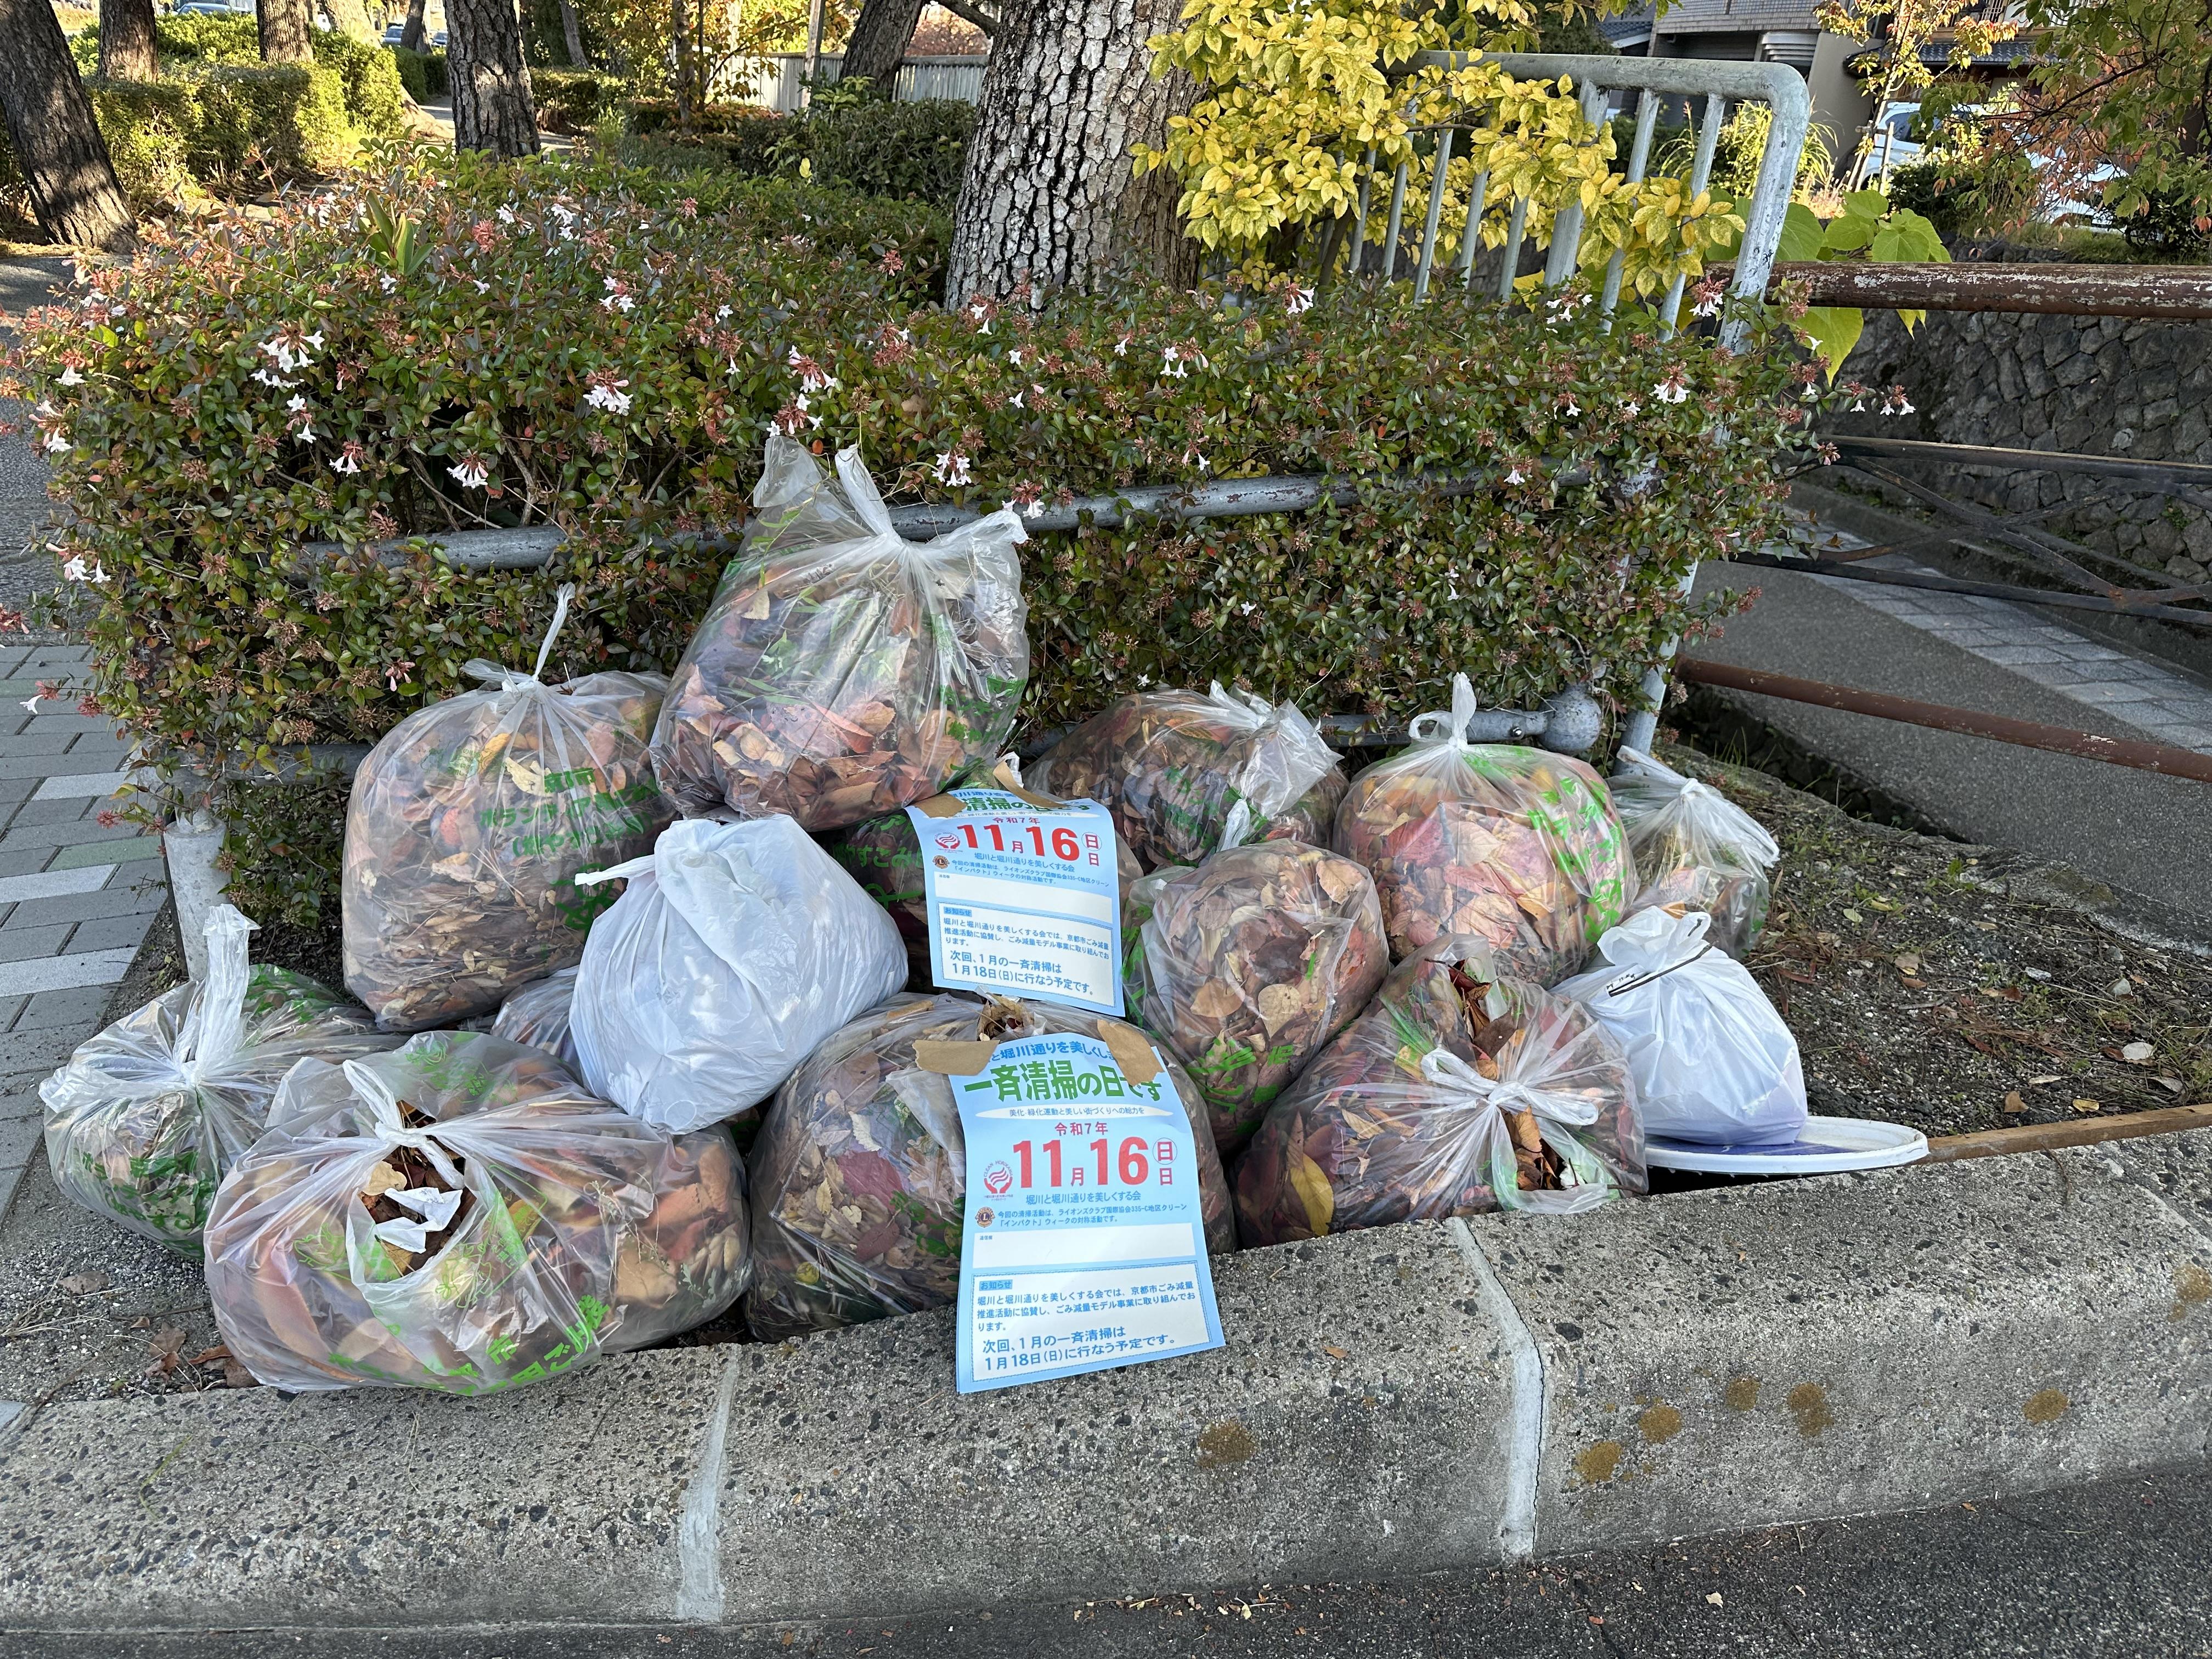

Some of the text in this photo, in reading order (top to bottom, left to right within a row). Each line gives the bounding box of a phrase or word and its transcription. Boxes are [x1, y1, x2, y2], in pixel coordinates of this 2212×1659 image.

[974, 852, 1075, 872] 堀川と堀川通りを美しくする会
[944, 907, 972, 917] お知らせ
[945, 937, 969, 947] ります。
[1054, 1121, 1108, 1136] 令和7年
[1025, 1191, 1142, 1205] 堀川と堀川通りを美しくする会
[980, 1280, 1012, 1290] お知らせ
[978, 1281, 1194, 1306] 堀川と堀川通りを美しくする会では、京都市ごみ減量
[978, 1323, 1007, 1331] ります。
